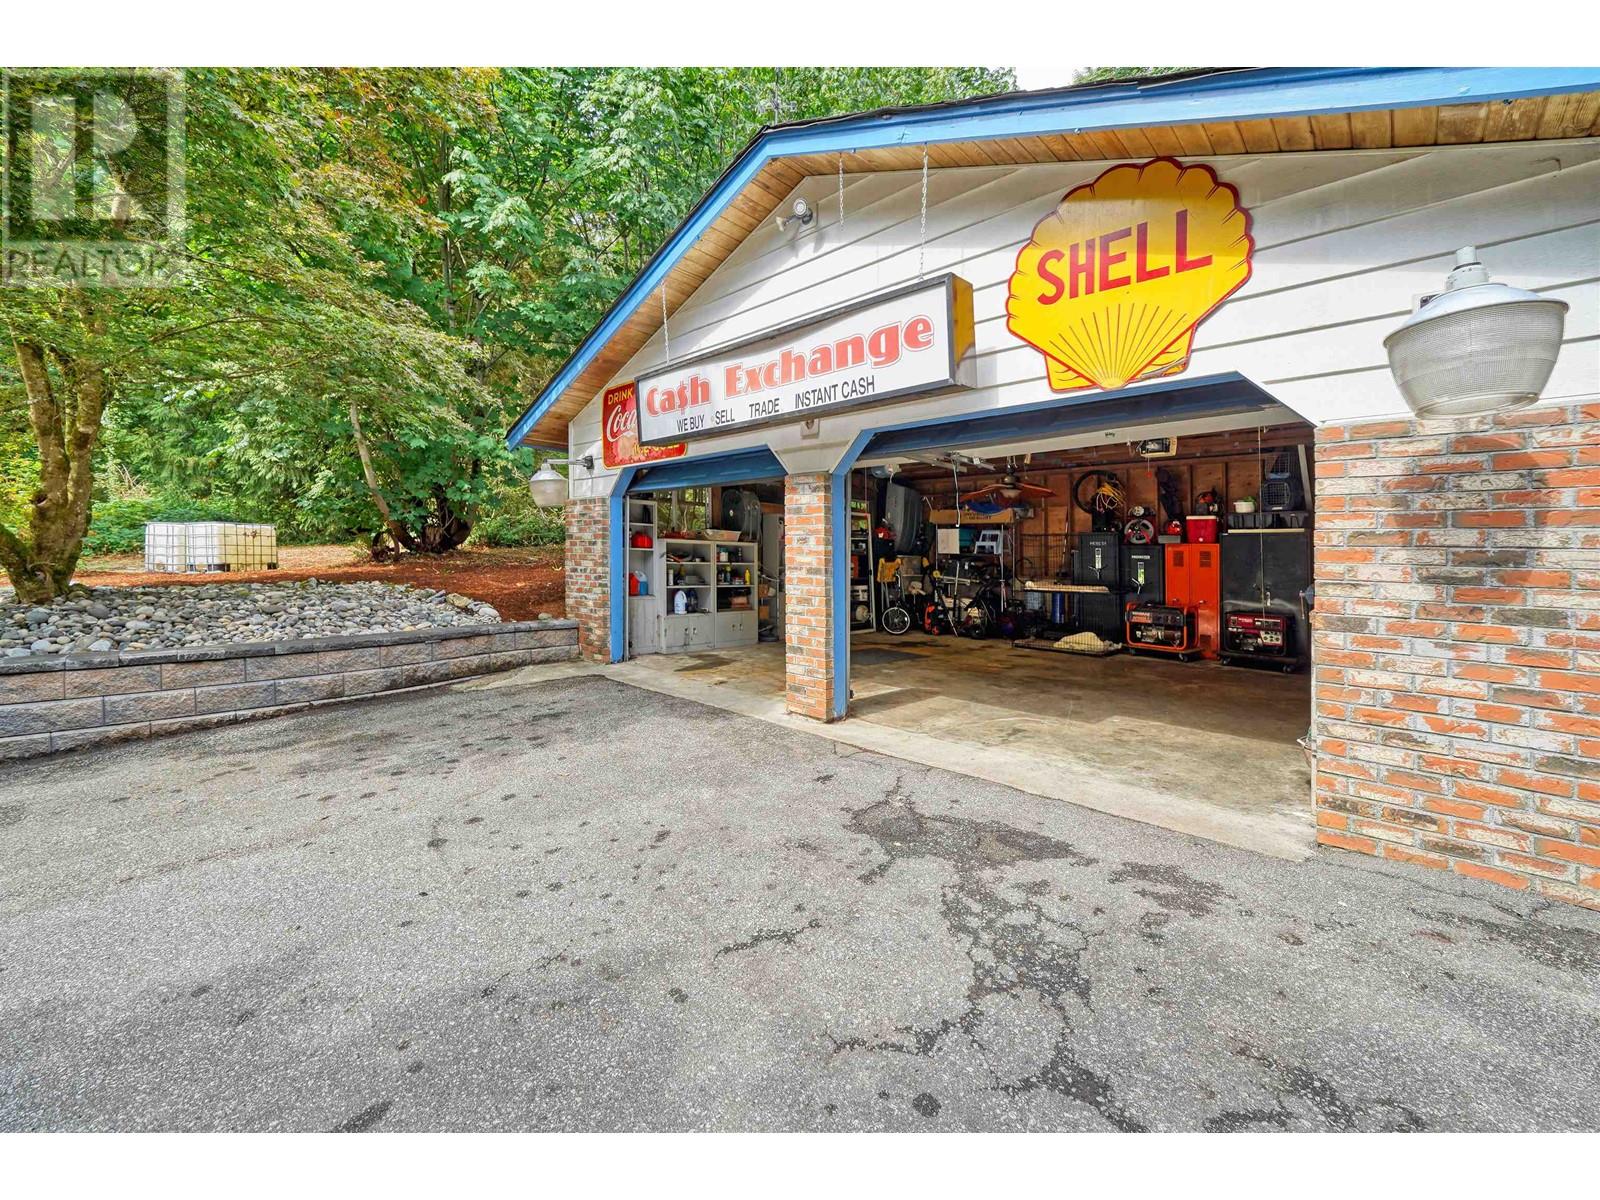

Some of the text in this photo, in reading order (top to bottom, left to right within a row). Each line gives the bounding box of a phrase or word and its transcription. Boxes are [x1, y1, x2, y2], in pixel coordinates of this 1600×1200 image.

[1037, 209, 1213, 305] SHELL
[724, 315, 935, 400] Exchange
[608, 387, 633, 405] DRINK
[677, 375, 875, 432] WE BUY SELL TRADE INSTANT CASH
